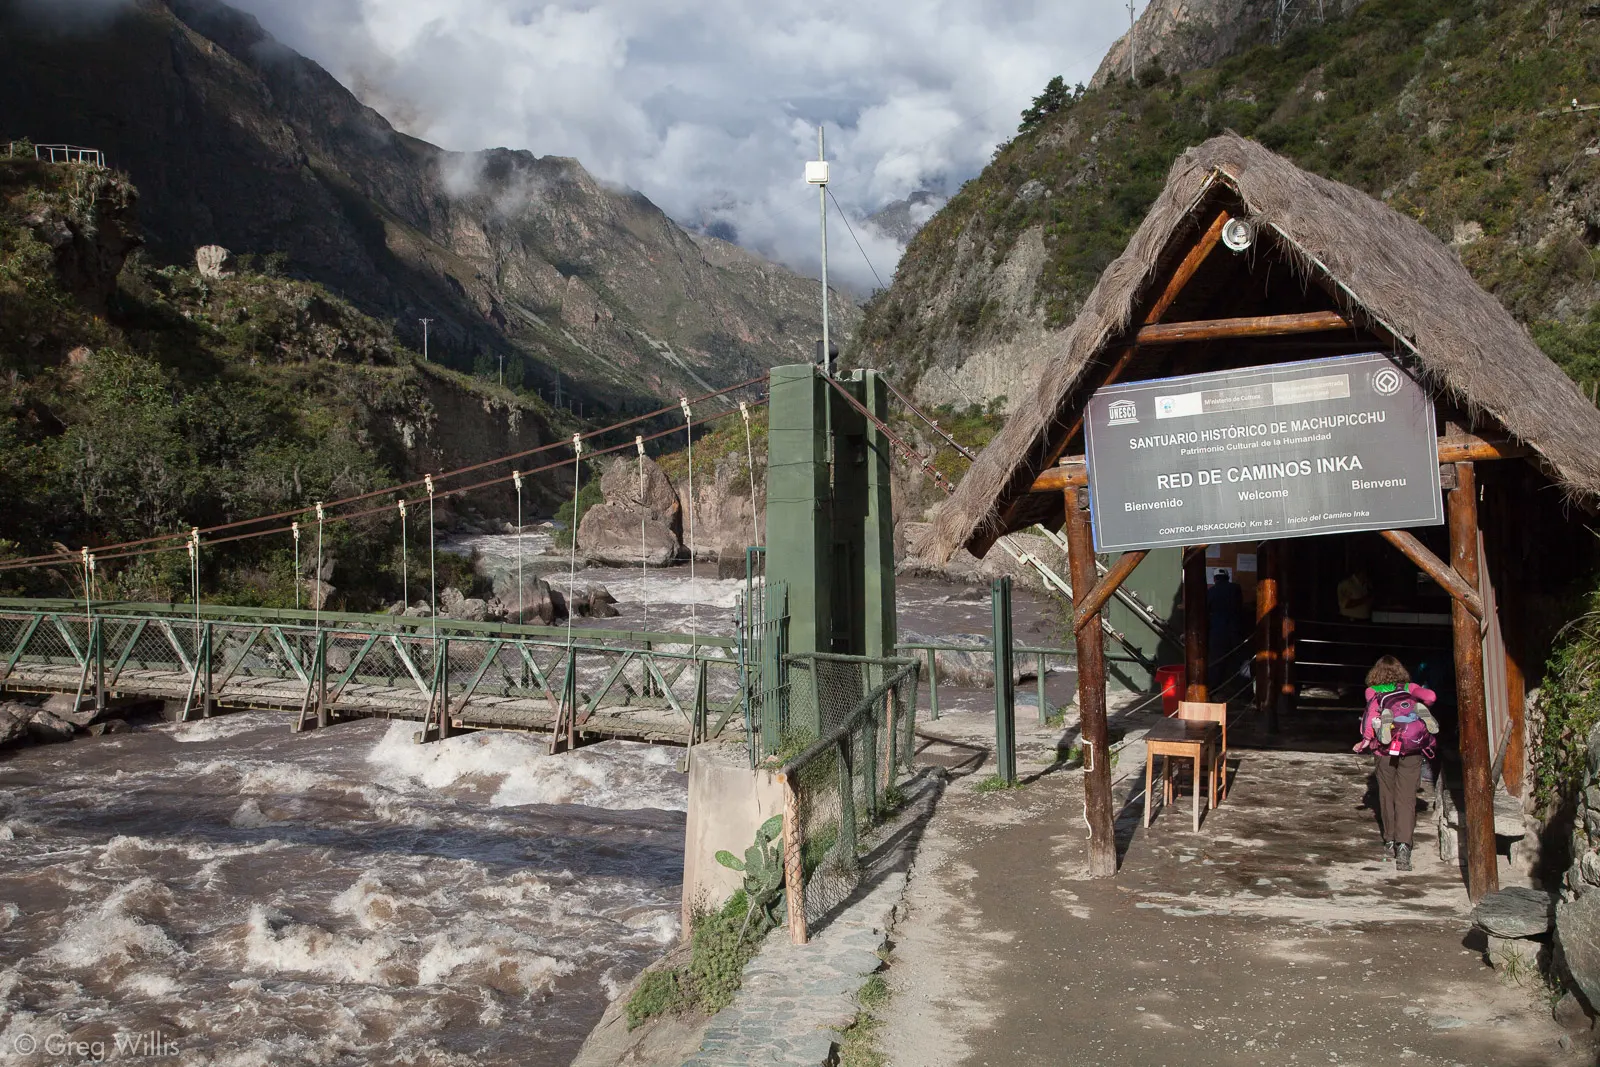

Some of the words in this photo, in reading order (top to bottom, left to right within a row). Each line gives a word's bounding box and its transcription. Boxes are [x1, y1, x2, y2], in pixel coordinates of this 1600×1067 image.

[1108, 405, 1137, 420] UNESCO
[1129, 431, 1198, 450] SANTUARIO
[1201, 423, 1268, 442] HISTÓRICO
[1271, 421, 1288, 434] DE
[1291, 410, 1387, 432] MACHUPICCHU
[1180, 444, 1225, 456] Patrimonio
[1226, 440, 1259, 451] Cultural
[1260, 439, 1272, 447] de
[1273, 438, 1281, 446] la
[1283, 432, 1332, 445] Humanidad
[1157, 472, 1193, 490] RED
[1198, 469, 1222, 486] DE
[1227, 460, 1312, 483] CAMINOS
[1316, 455, 1364, 474] INKA
[1351, 477, 1407, 490] Bienvenu
[1124, 497, 1184, 512] Bienvenido
[1237, 489, 1289, 501] Welcome
[1159, 525, 1195, 535] CONTROL
[1196, 521, 1246, 532] PISKACUCHO
[1249, 520, 1262, 528] Km
[1263, 519, 1273, 527] 82
[1287, 515, 1308, 524] Inicio
[1309, 513, 1321, 522] del
[1322, 511, 1352, 520] Camino
[1353, 509, 1370, 518] Inka
